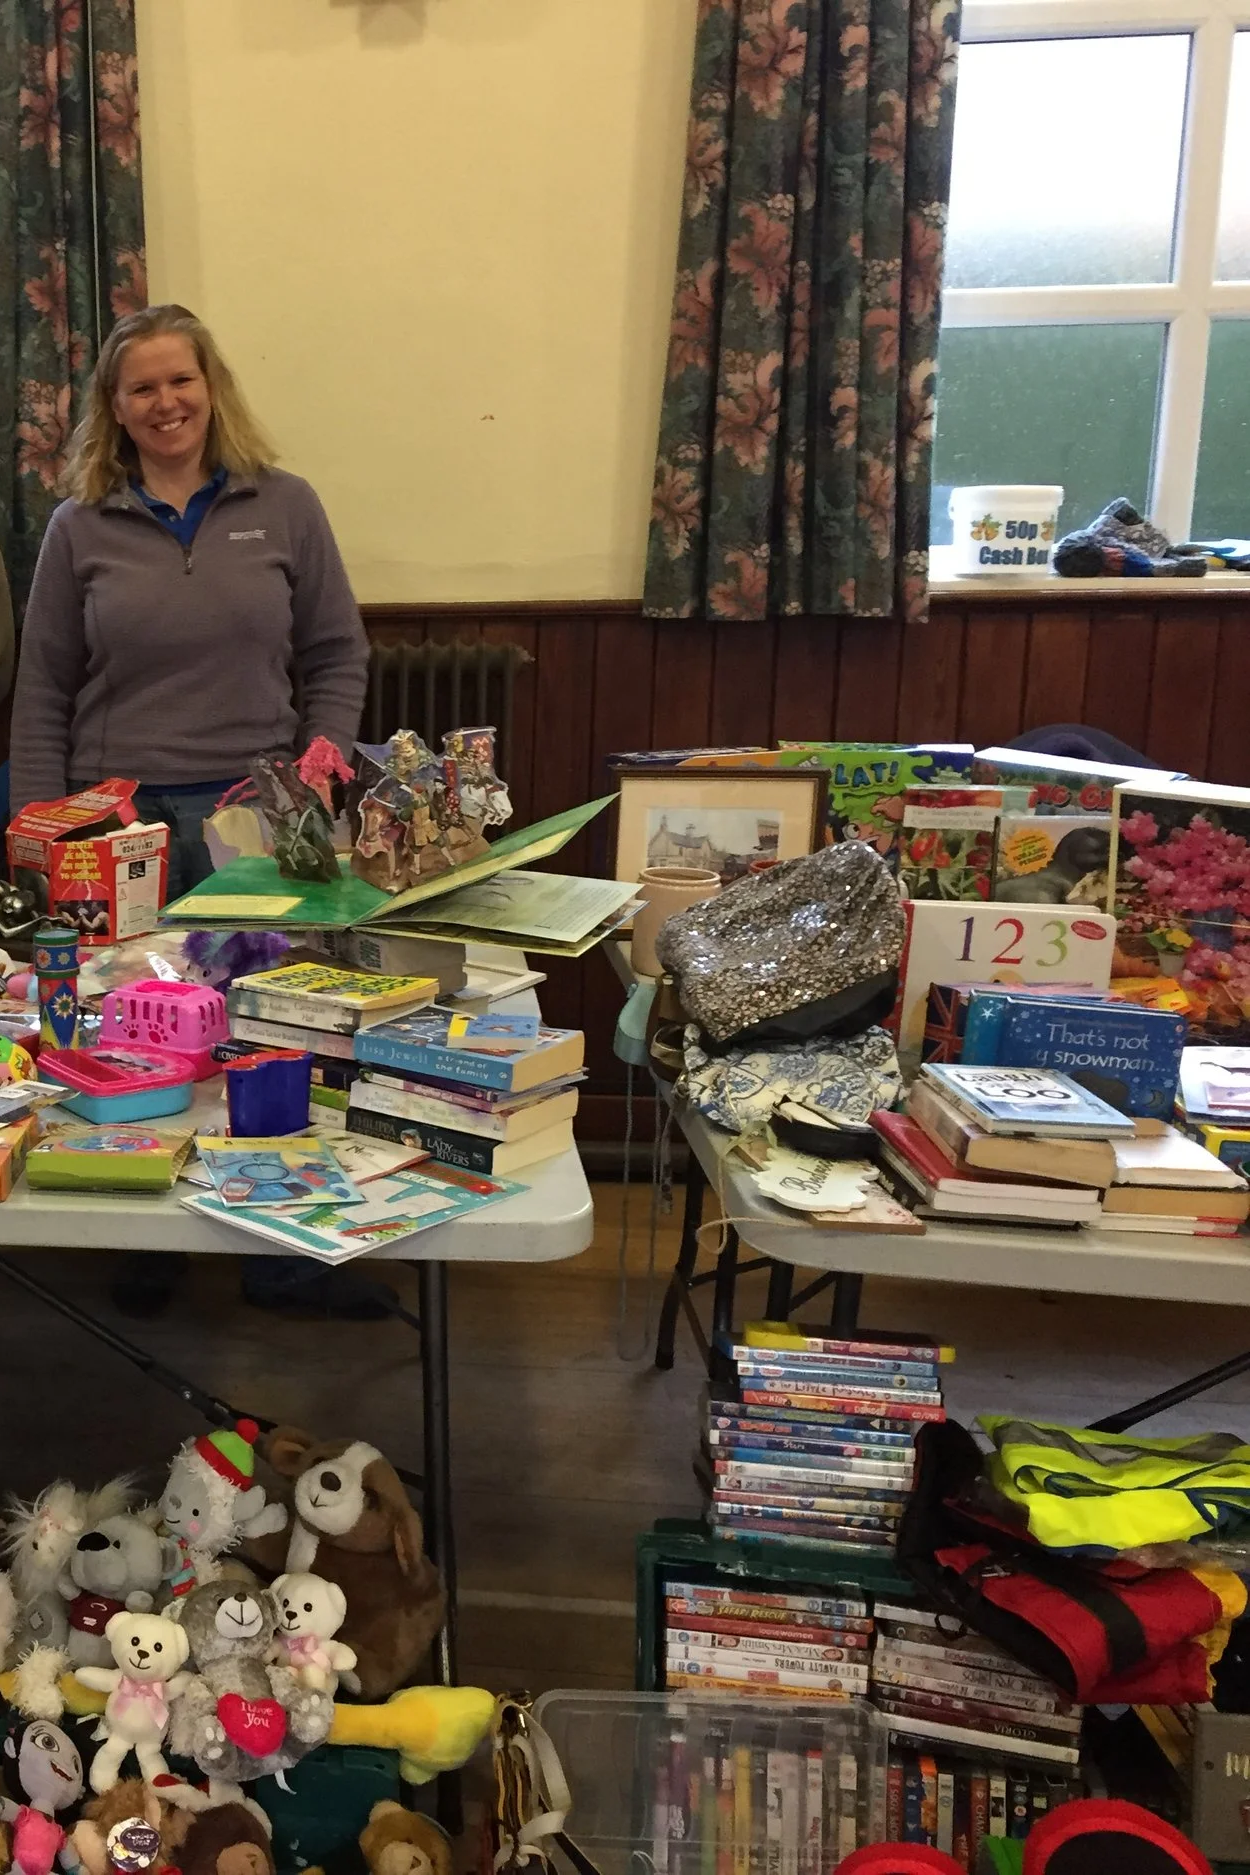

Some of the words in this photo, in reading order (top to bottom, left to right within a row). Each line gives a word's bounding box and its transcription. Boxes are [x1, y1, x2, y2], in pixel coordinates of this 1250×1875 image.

[1006, 520, 1038, 541] 50p
[979, 546, 1023, 565] Cash
[1046, 1023, 1106, 1046] That's
[1114, 1034, 1150, 1050] not
[361, 1041, 385, 1057] Lisa
[389, 1047, 429, 1065] Jewell
[975, 1087, 1072, 1100] LOO
[427, 1138, 454, 1152] LADY
[436, 1149, 470, 1167] RIVERS
[717, 1606, 749, 1618] SAFARI
[750, 1608, 788, 1621] RESCUE
[243, 1712, 270, 1729] You
[993, 1723, 1037, 1739] GLORIA
